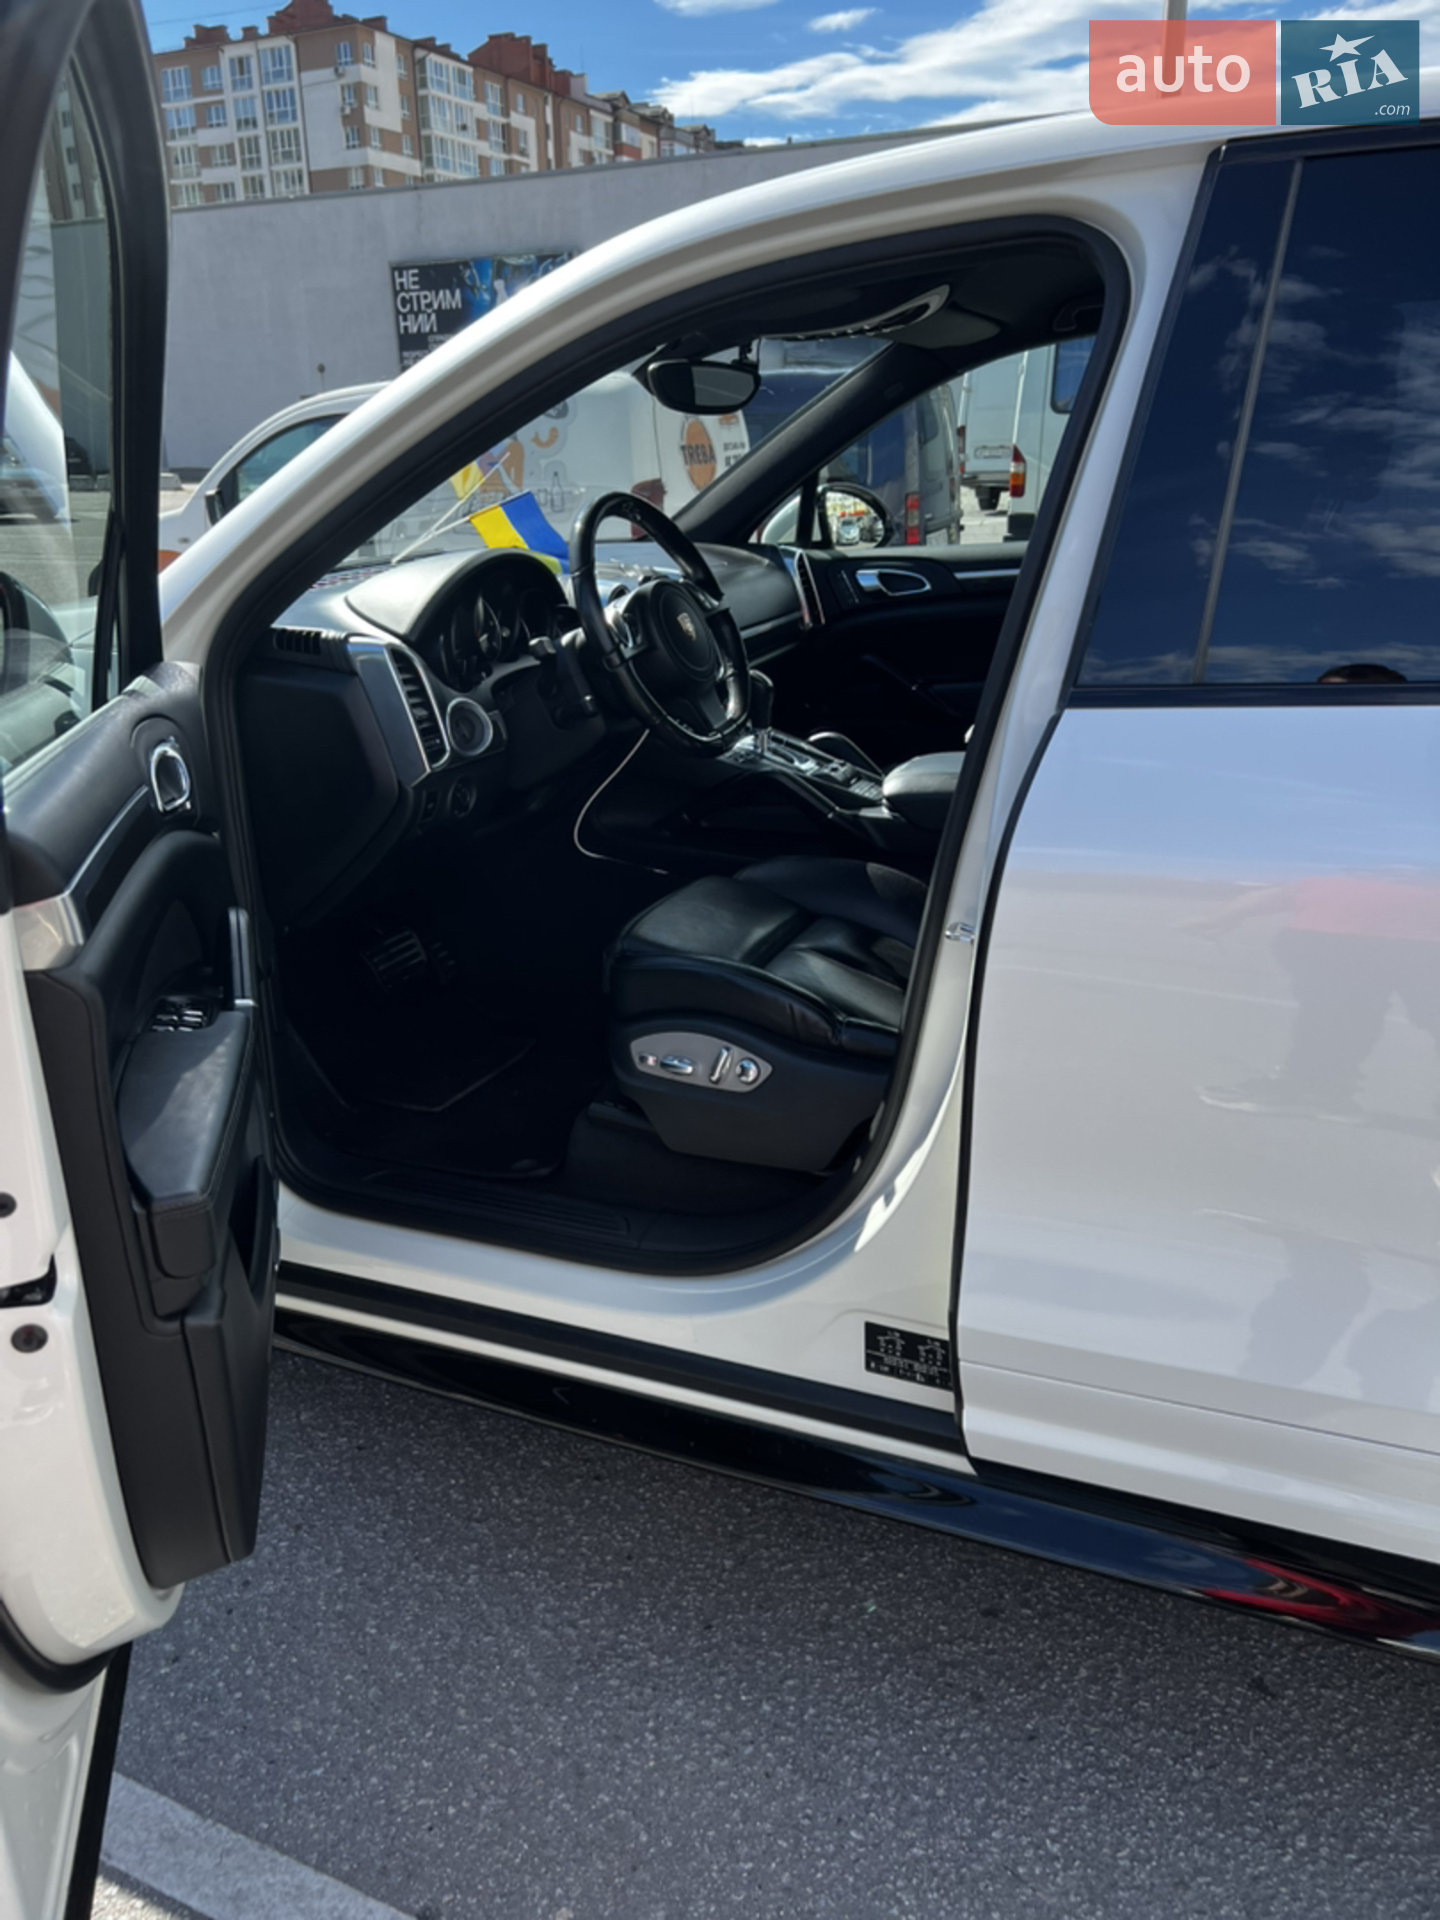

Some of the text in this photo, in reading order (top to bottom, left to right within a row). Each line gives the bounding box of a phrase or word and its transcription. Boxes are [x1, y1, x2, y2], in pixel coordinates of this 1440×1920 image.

[394, 269, 420, 290] НЕ
[397, 288, 462, 313] СТРИМ
[398, 309, 438, 334] НИЙ
